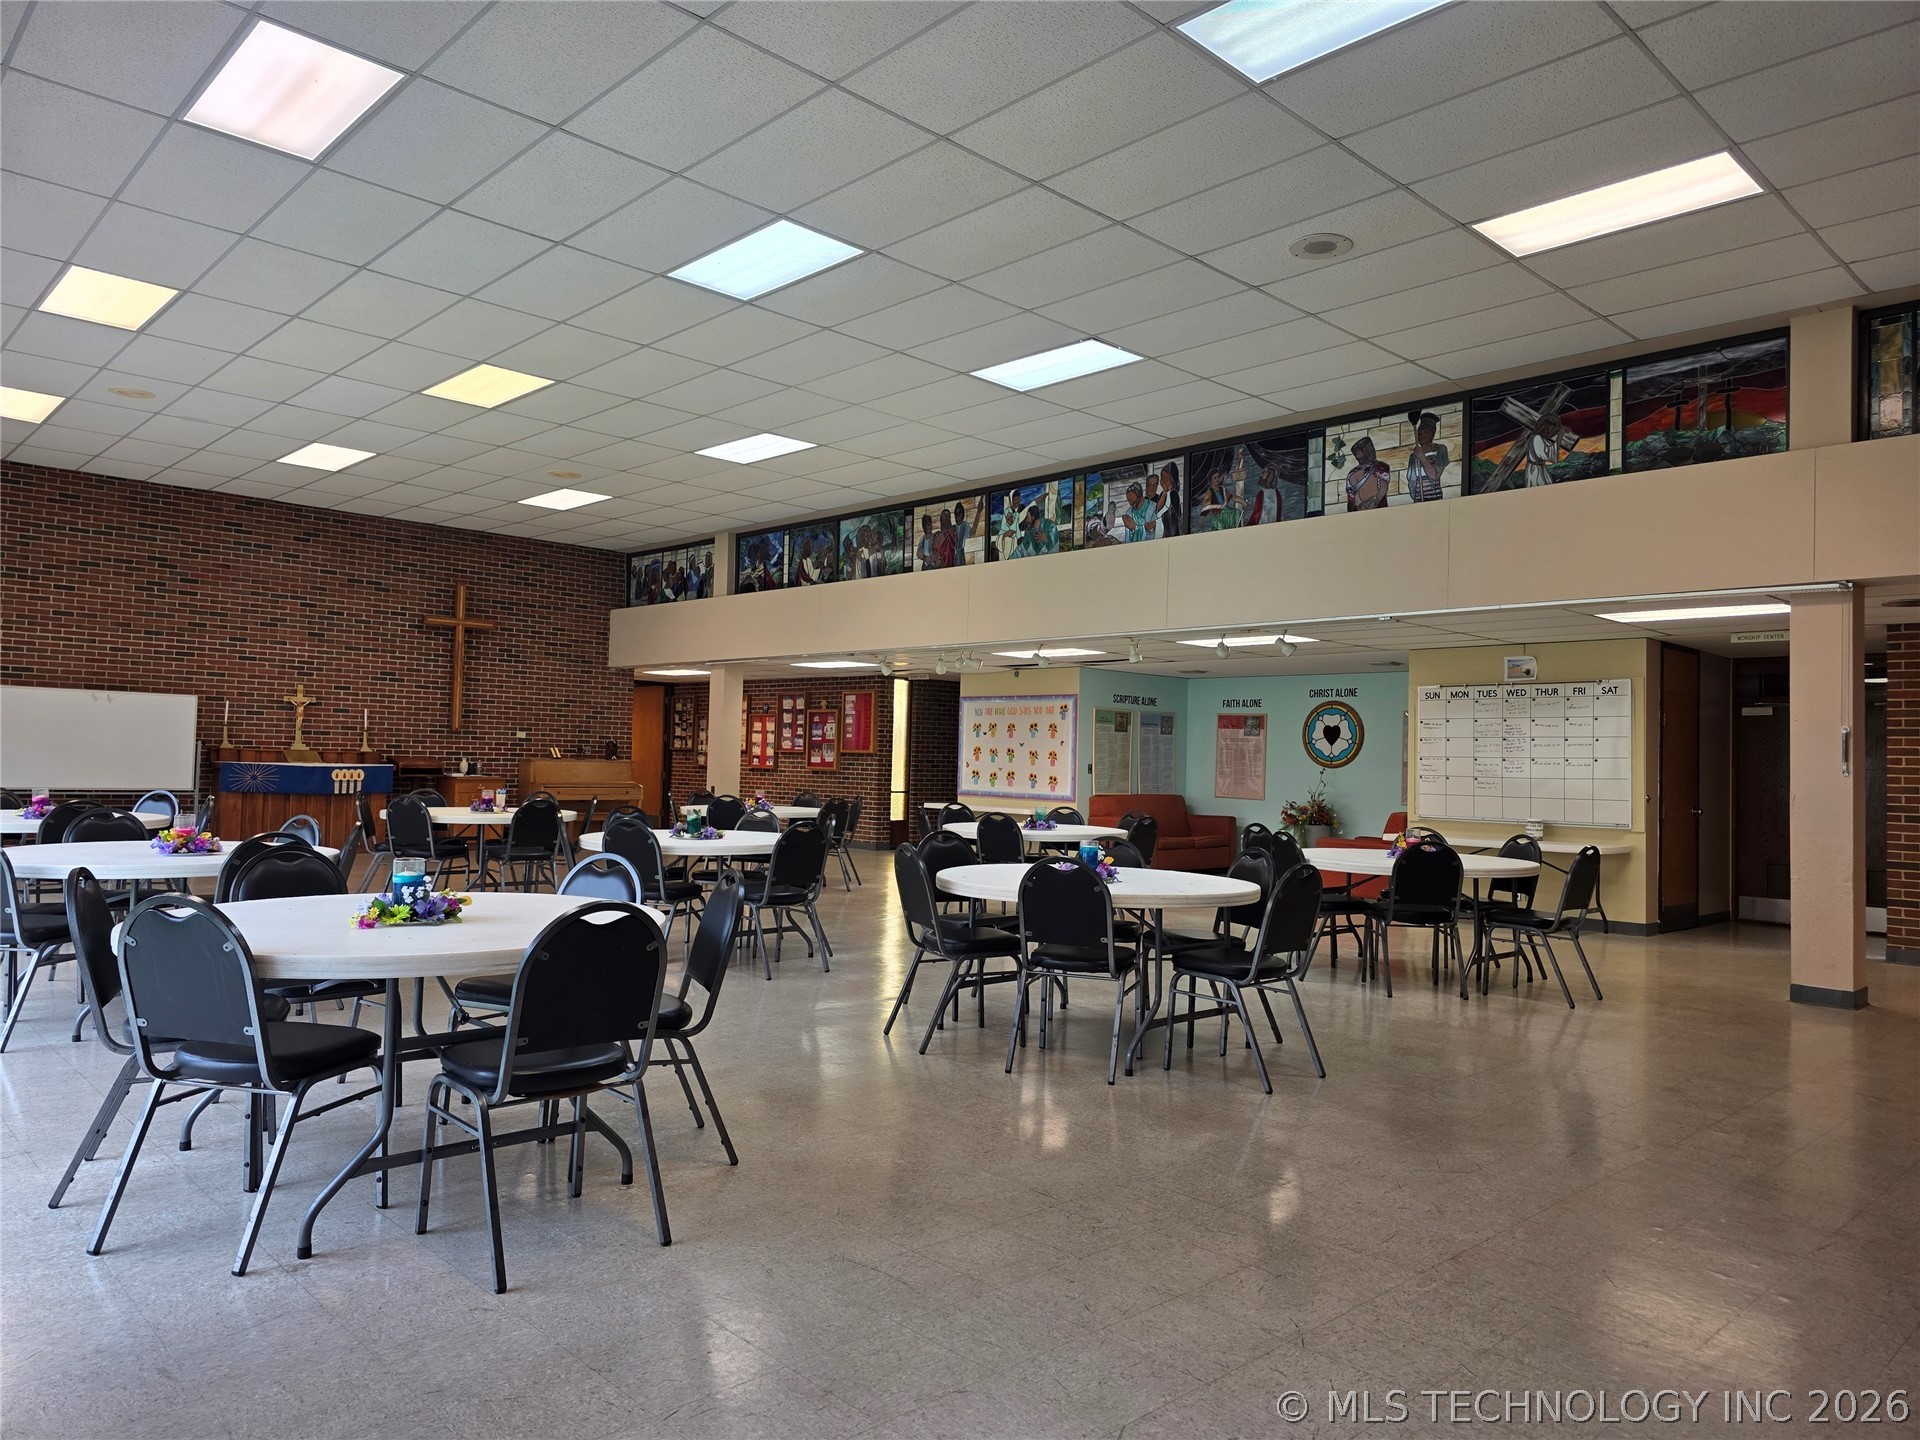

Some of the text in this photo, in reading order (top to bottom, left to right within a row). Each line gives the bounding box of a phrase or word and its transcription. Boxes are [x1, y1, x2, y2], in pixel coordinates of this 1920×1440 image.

[1309, 688, 1358, 698] CHRIST ALONE
[1477, 690, 1498, 698] TUES
[1506, 689, 1527, 697] WED
[1535, 688, 1559, 696] THUR
[1573, 687, 1586, 695] FRI
[1601, 686, 1618, 694] SAT
[1113, 694, 1157, 706] SCRIPTURE ALONE
[1222, 699, 1262, 708] FAITH ALONE
[1007, 706, 1018, 715] GOD
